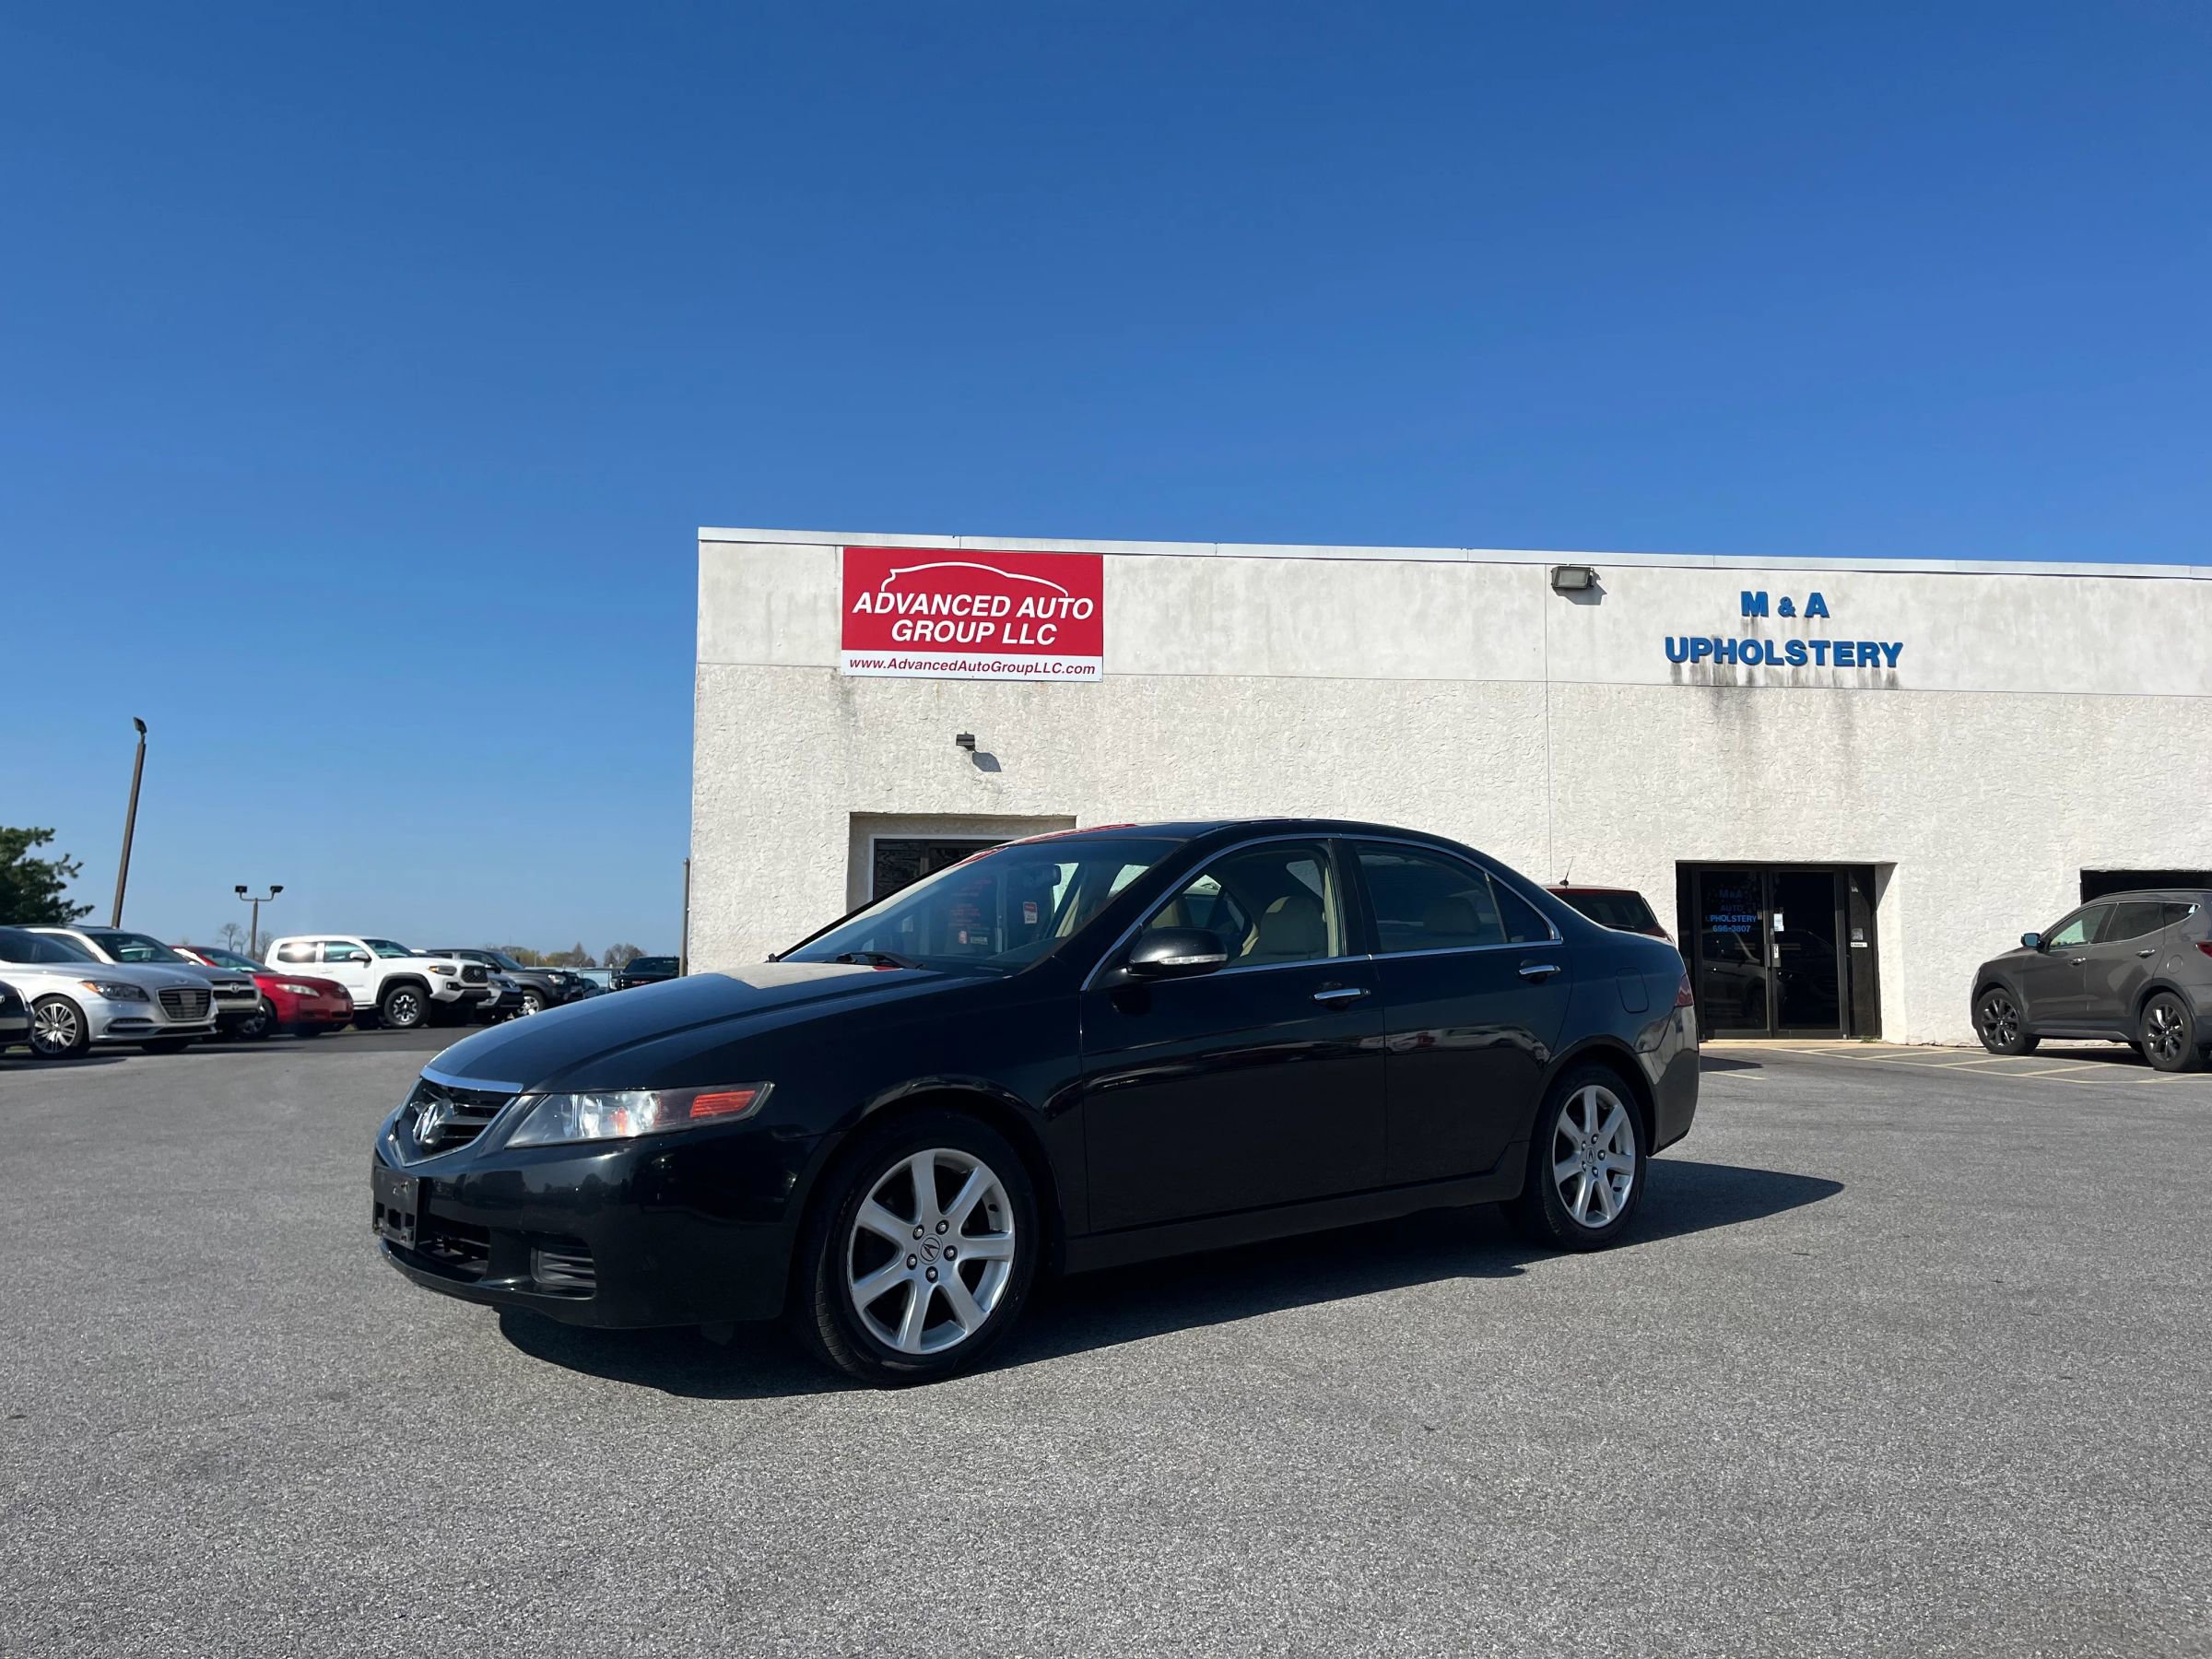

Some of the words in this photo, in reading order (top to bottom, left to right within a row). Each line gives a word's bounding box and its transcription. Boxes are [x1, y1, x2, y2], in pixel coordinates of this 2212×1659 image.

[853, 592, 1011, 617] ADVANCED
[1016, 597, 1094, 619] AUTO
[1741, 591, 1769, 618] M
[1778, 596, 1796, 618] &
[1804, 592, 1830, 618] A
[891, 619, 994, 643] GROUP
[1002, 623, 1057, 645] LLC
[1665, 636, 1903, 668] UPHOLSTERY
[849, 657, 1096, 676] www.AdvancedAutoGroupLLC.com
[1705, 914, 1757, 923] UPHOLSTERY
